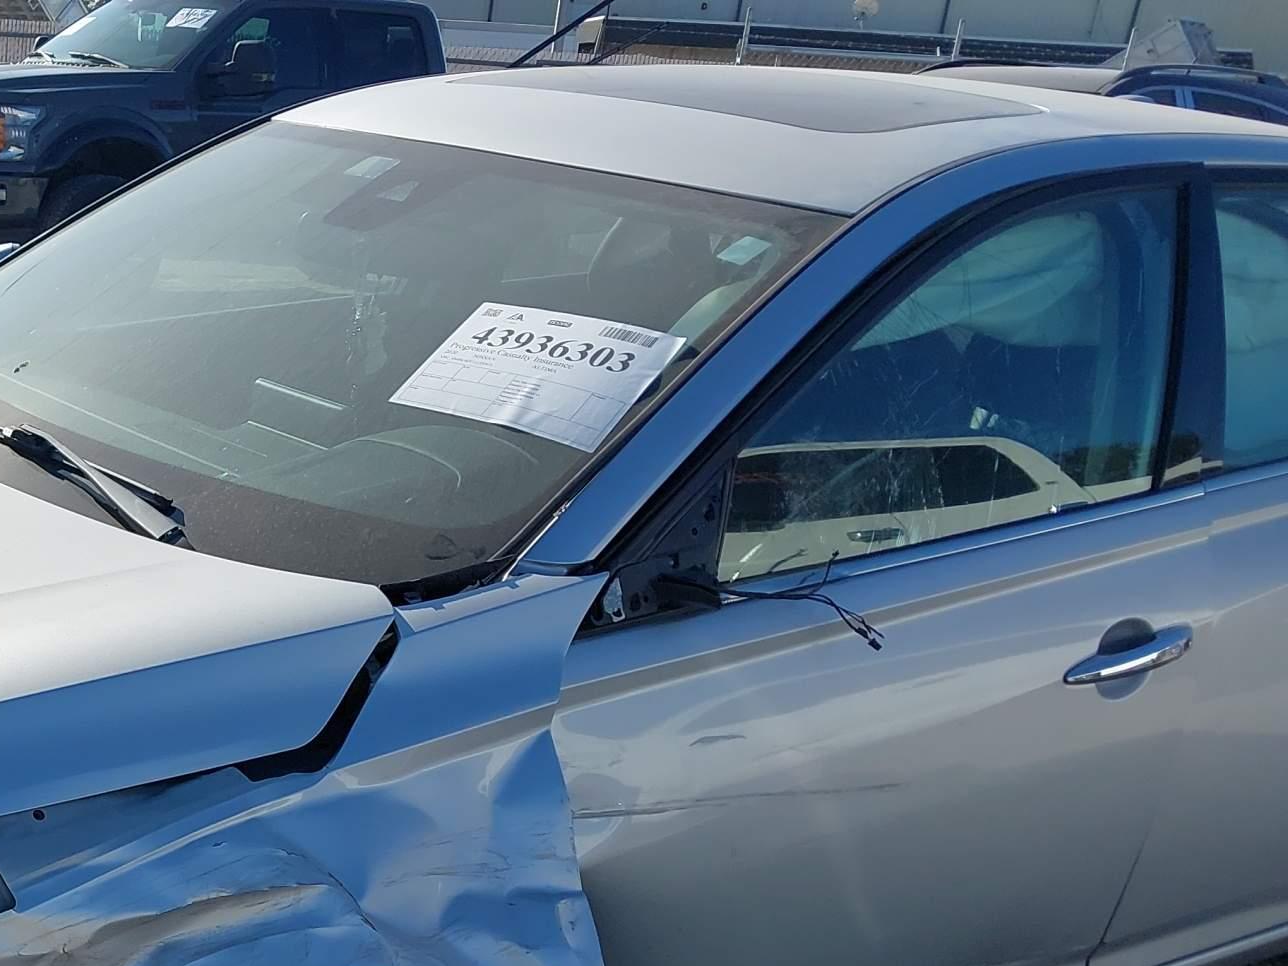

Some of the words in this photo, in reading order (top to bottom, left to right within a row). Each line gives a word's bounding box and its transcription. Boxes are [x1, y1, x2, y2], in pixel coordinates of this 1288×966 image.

[472, 327, 636, 373] 43936303
[497, 350, 531, 361] Casualty
[534, 356, 574, 370] Insurance
